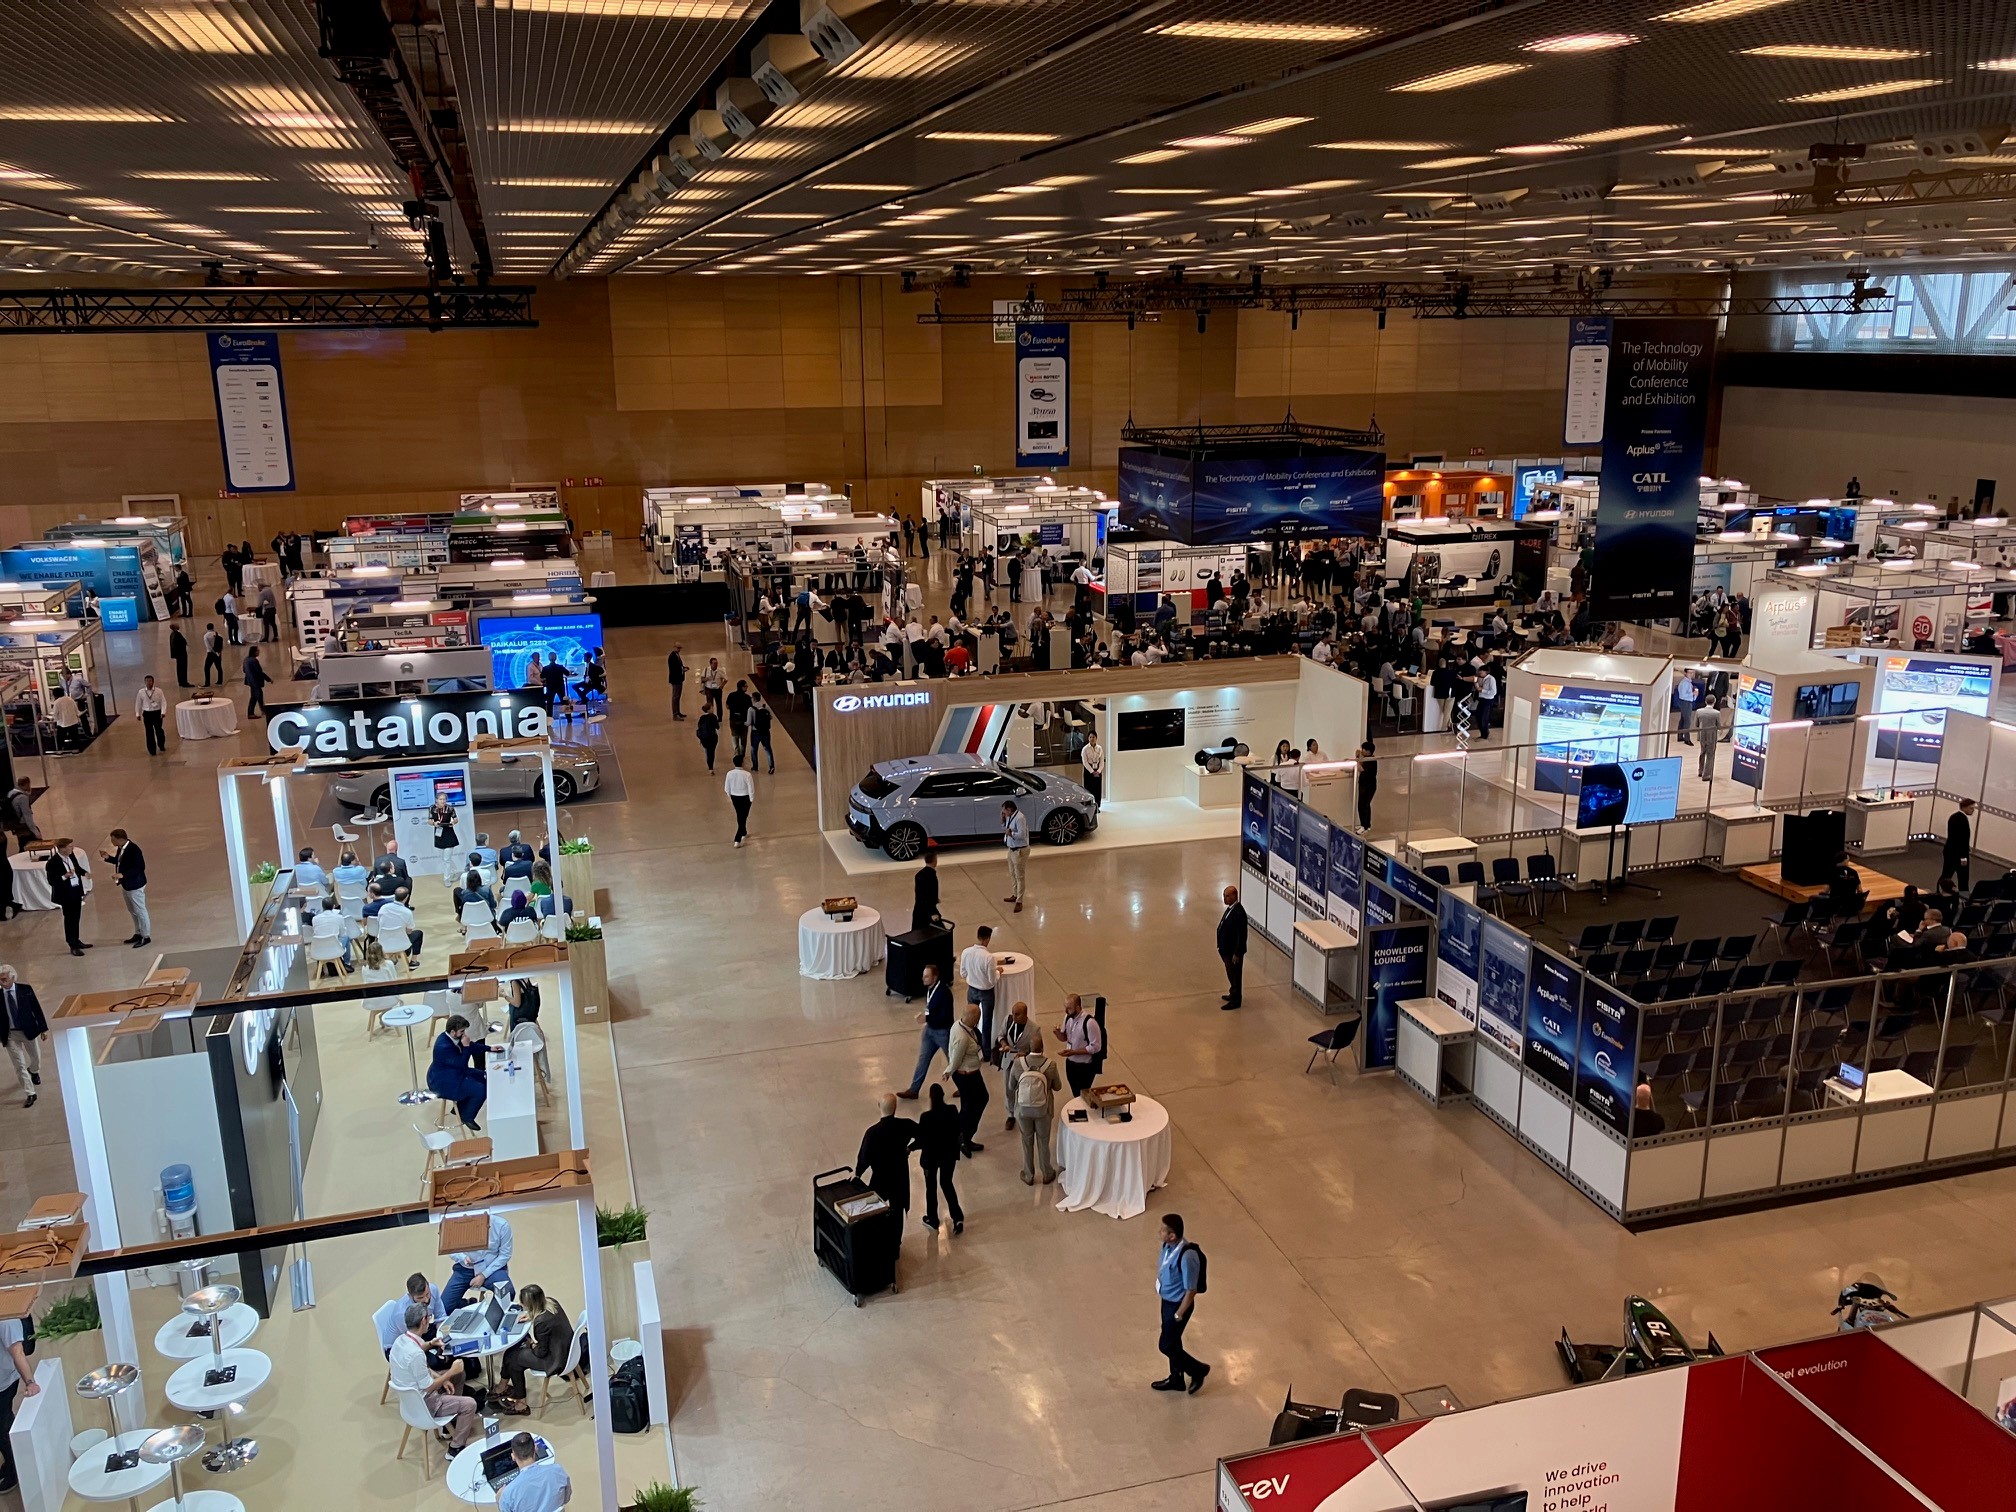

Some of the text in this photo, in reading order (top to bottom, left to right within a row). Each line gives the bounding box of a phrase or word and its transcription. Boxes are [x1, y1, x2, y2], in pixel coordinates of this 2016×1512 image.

[232, 339, 266, 347] EuroBrake
[1032, 336, 1066, 345] EuroBrake
[1621, 341, 1703, 356] The Technology
[1633, 358, 1689, 374] of Mobility
[1629, 375, 1689, 388] Conference
[1621, 393, 1696, 405] and Exhibition
[1626, 444, 1656, 457] Applus
[1205, 469, 1376, 485] The Technology of Mobility Conference and Exhibition
[1632, 472, 1670, 483] CATL
[1639, 510, 1675, 518] HYUNDAI
[1765, 600, 1800, 615] Applus
[1914, 622, 1930, 635] 30
[864, 692, 930, 708] HYUNDAI
[267, 698, 549, 753] Catalonia
[1367, 900, 1393, 922] KNOWLEDGE
[1367, 907, 1384, 924] LOUNGE
[1374, 945, 1424, 957] KNOWLEDGE
[1374, 955, 1406, 966] LOUNGE
[1544, 964, 1569, 982] Prime Partners
[1537, 985, 1554, 1003] Applus
[1596, 1000, 1621, 1020] FISITA
[1543, 1016, 1561, 1033] CATL
[1601, 1030, 1624, 1051] EuroBrake
[1543, 1047, 1570, 1071] HYUNDAI
[1589, 1087, 1610, 1107] FISITA
[1797, 1359, 1848, 1377] evolution
[487, 1425, 497, 1435] 10
[1545, 1462, 1607, 1482] We drive
[1544, 1474, 1620, 1498] innovation
[1543, 1494, 1591, 1512] to help
